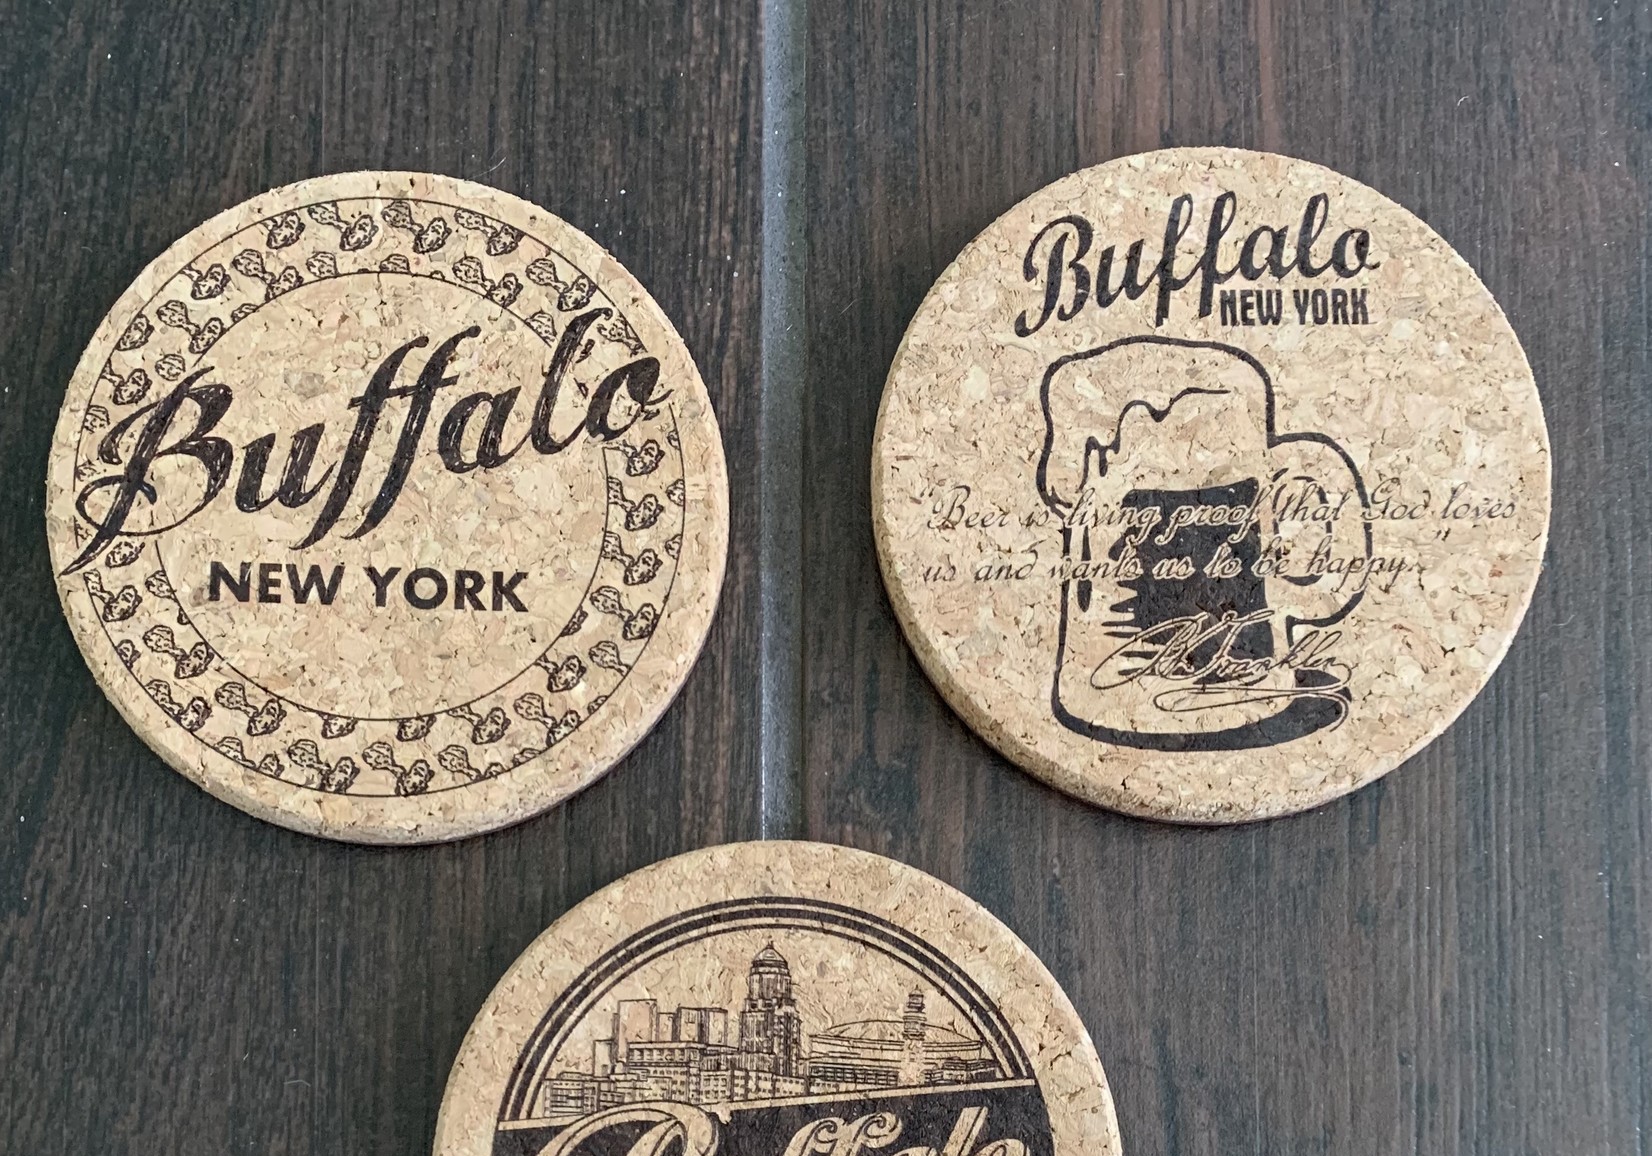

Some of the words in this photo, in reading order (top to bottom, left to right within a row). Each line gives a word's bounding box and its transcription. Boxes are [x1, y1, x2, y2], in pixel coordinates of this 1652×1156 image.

[1014, 190, 1380, 339] Buffalo
[1219, 288, 1284, 328] NEW
[1293, 286, 1371, 326] YORK
[58, 306, 672, 576] Buffalo
[1018, 504, 1050, 528] is
[1062, 487, 1162, 543] living
[1155, 483, 1275, 544] proof
[1276, 483, 1350, 522] that
[1361, 476, 1432, 521] God
[1441, 482, 1518, 520] loves
[208, 561, 344, 606] NEW
[363, 566, 530, 613] YORK
[922, 556, 957, 582] us
[973, 536, 1048, 583] and
[1048, 543, 1144, 582] wants
[1151, 553, 1196, 583] us
[1202, 542, 1243, 578] to
[1250, 535, 1290, 577] be
